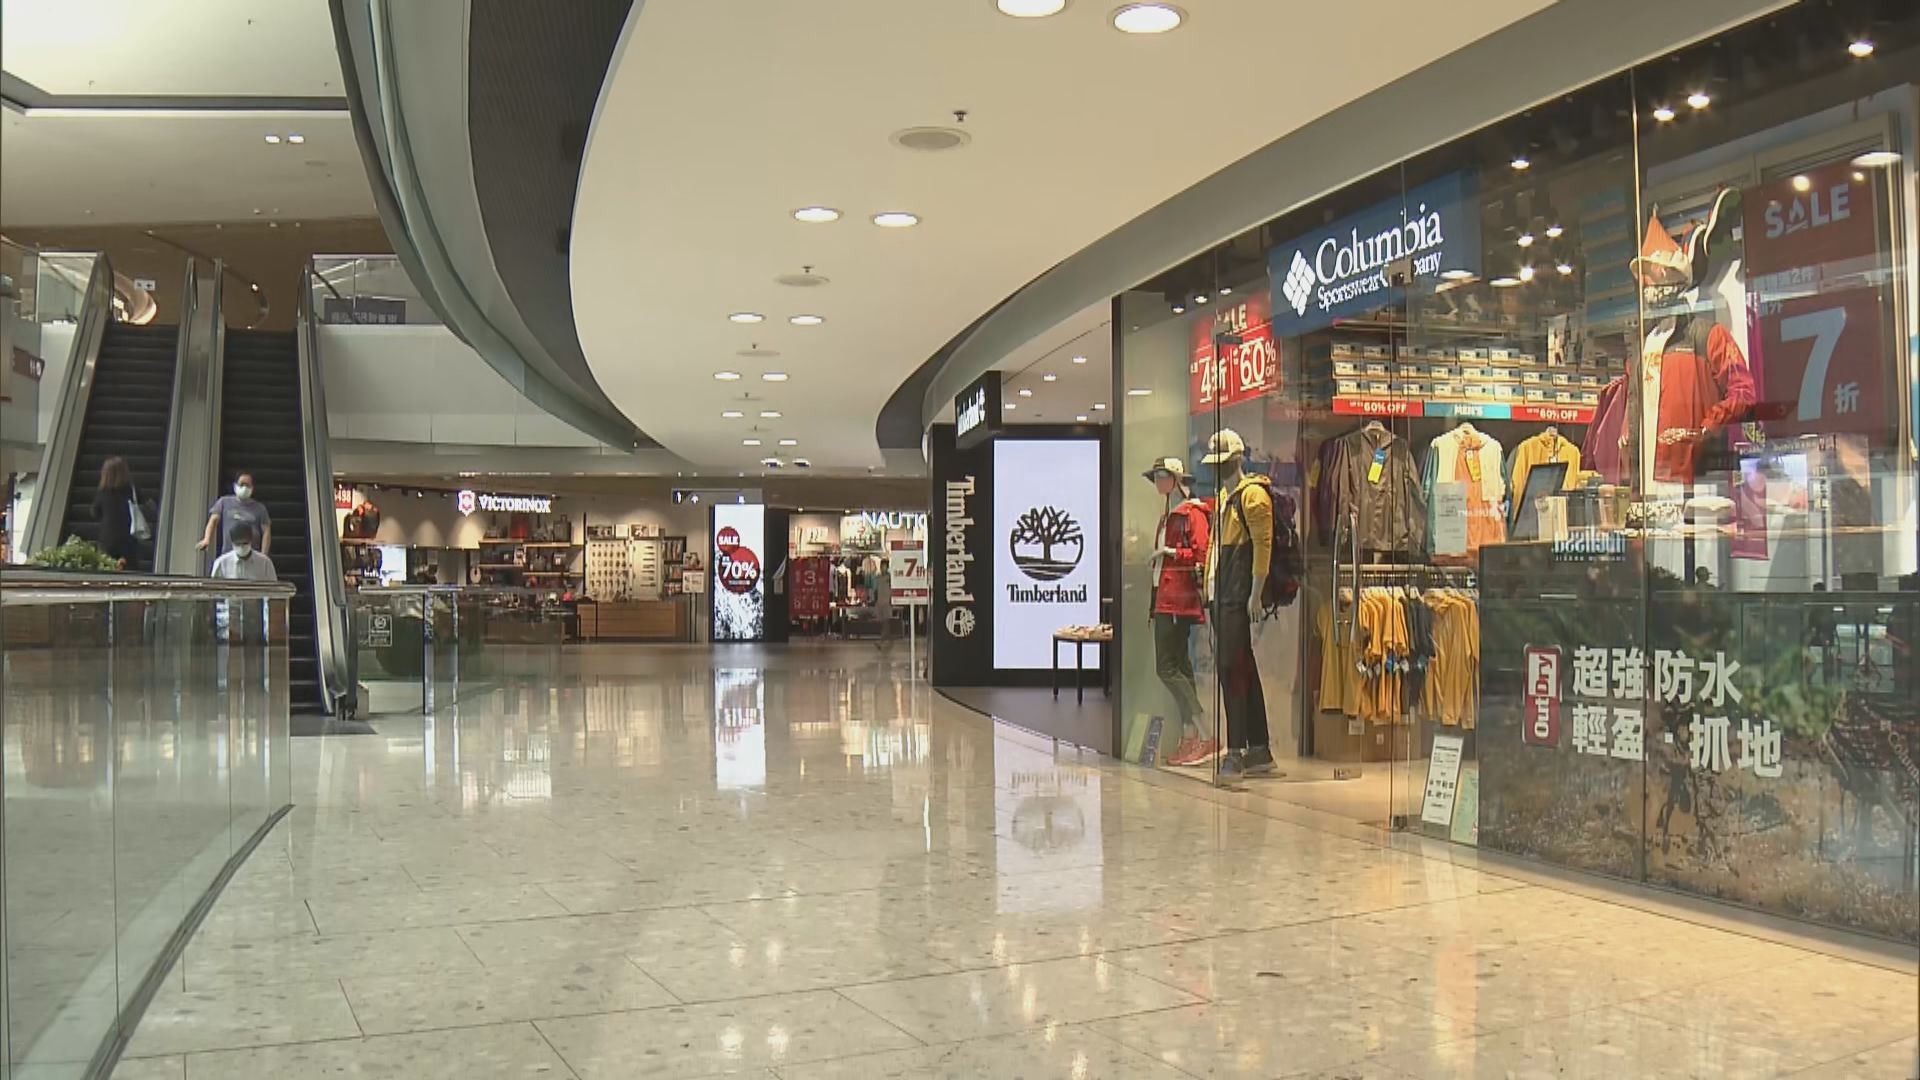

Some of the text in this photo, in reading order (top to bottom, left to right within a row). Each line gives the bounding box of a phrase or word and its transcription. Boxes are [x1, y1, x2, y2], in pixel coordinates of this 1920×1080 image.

[1316, 203, 1443, 285] Columbia
[1318, 275, 1379, 313] Sportswear
[1387, 402, 1407, 414] OFF
[1561, 410, 1578, 421] OFF
[478, 495, 551, 513] VICTORINOX
[718, 536, 739, 545] SALE
[946, 474, 975, 603] Timberland
[722, 561, 757, 579] 70%
[1007, 584, 1087, 603] Timberland
[1573, 645, 1743, 707] 超強防水
[1534, 655, 1553, 738] OutDry
